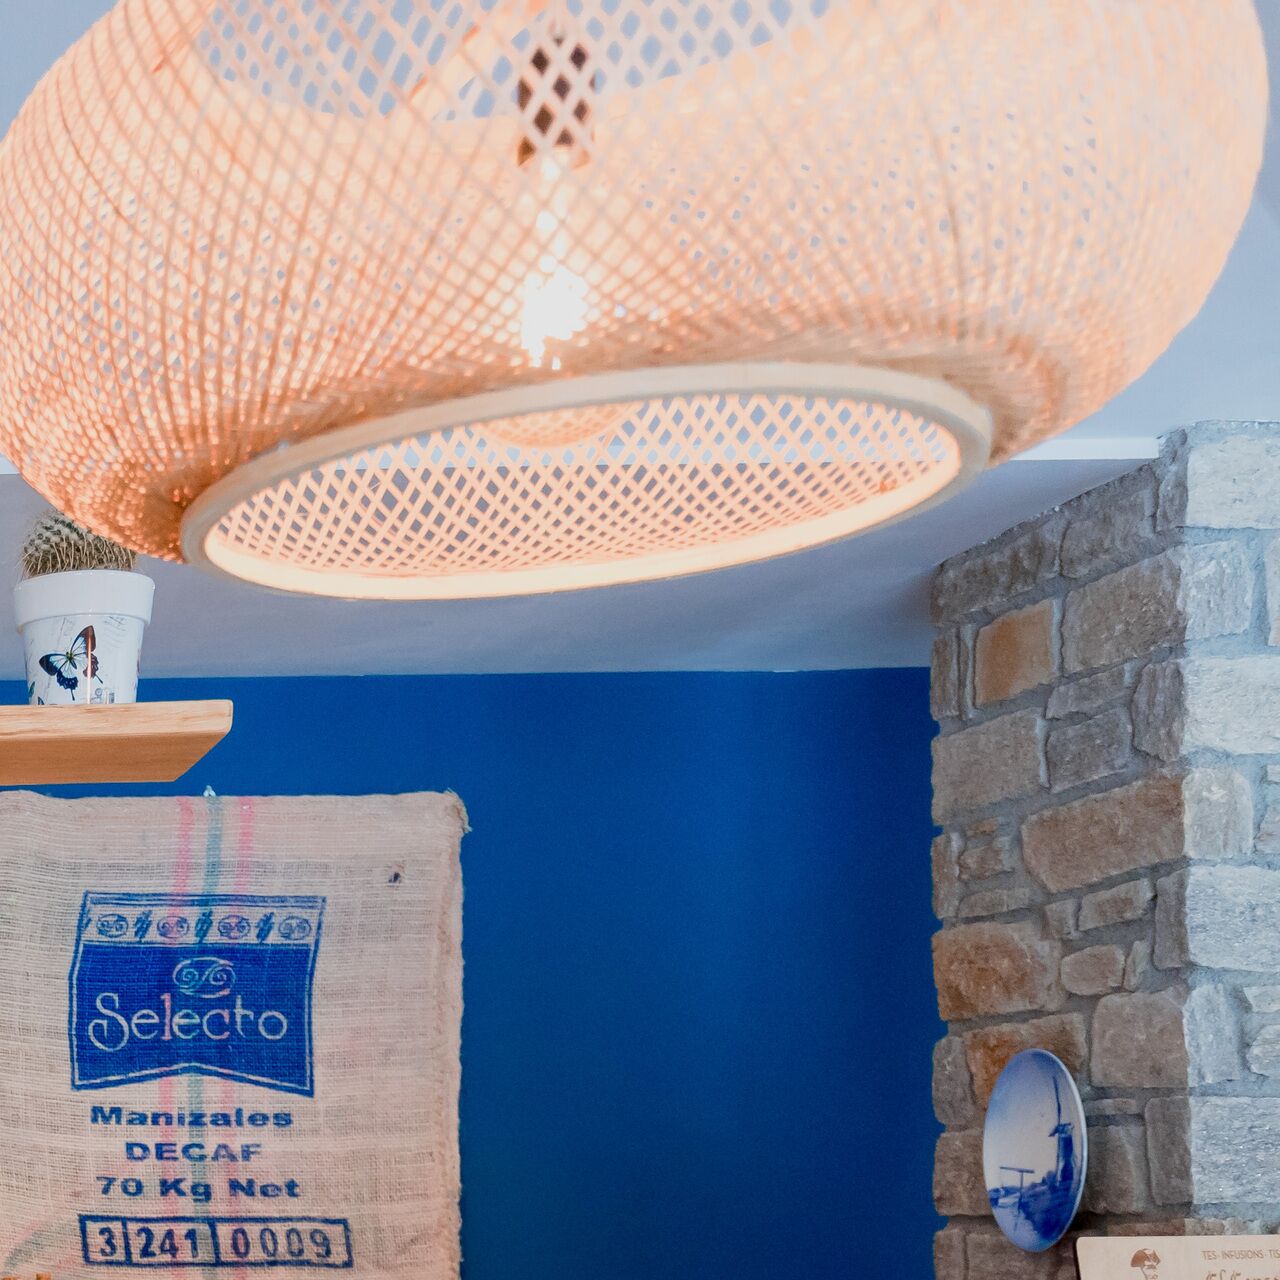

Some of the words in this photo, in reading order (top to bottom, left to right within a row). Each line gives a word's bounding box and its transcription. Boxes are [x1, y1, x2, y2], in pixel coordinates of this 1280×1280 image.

[87, 991, 289, 1051] Selecto
[90, 1105, 293, 1128] Manizales
[126, 1141, 263, 1163] DECAF
[97, 1176, 141, 1198] 70
[159, 1176, 213, 1202] Kg
[228, 1176, 300, 1199] Net
[98, 1226, 115, 1256] 3
[139, 1226, 200, 1257] 241
